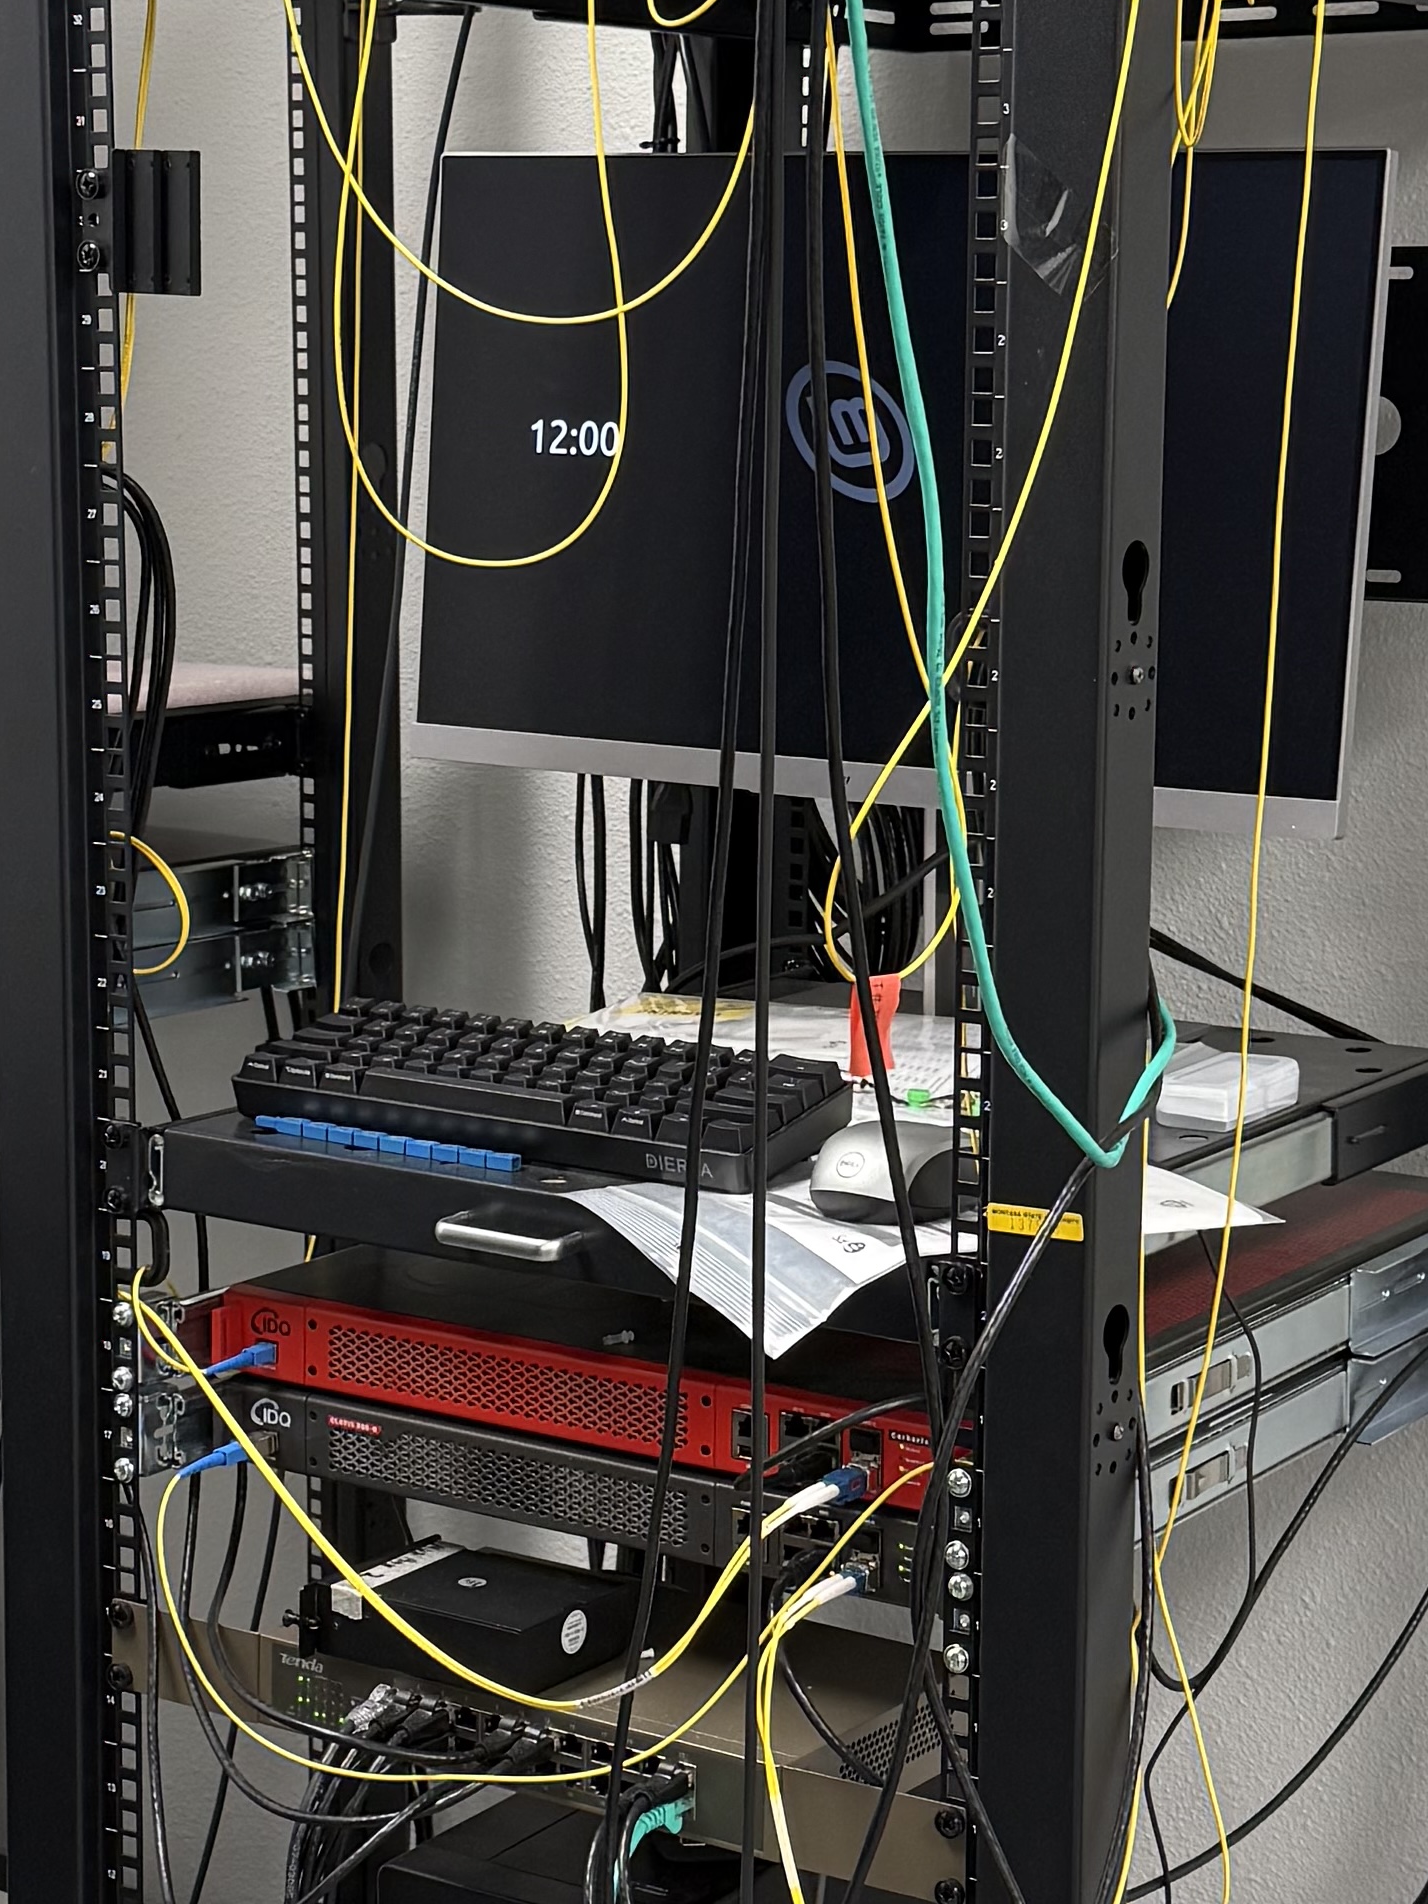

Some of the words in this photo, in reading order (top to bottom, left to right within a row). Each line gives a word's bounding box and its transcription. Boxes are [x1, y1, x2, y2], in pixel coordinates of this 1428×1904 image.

[531, 419, 620, 457] 12:00
[645, 1153, 714, 1179] DIERA
[280, 1653, 324, 1673] Tenda
